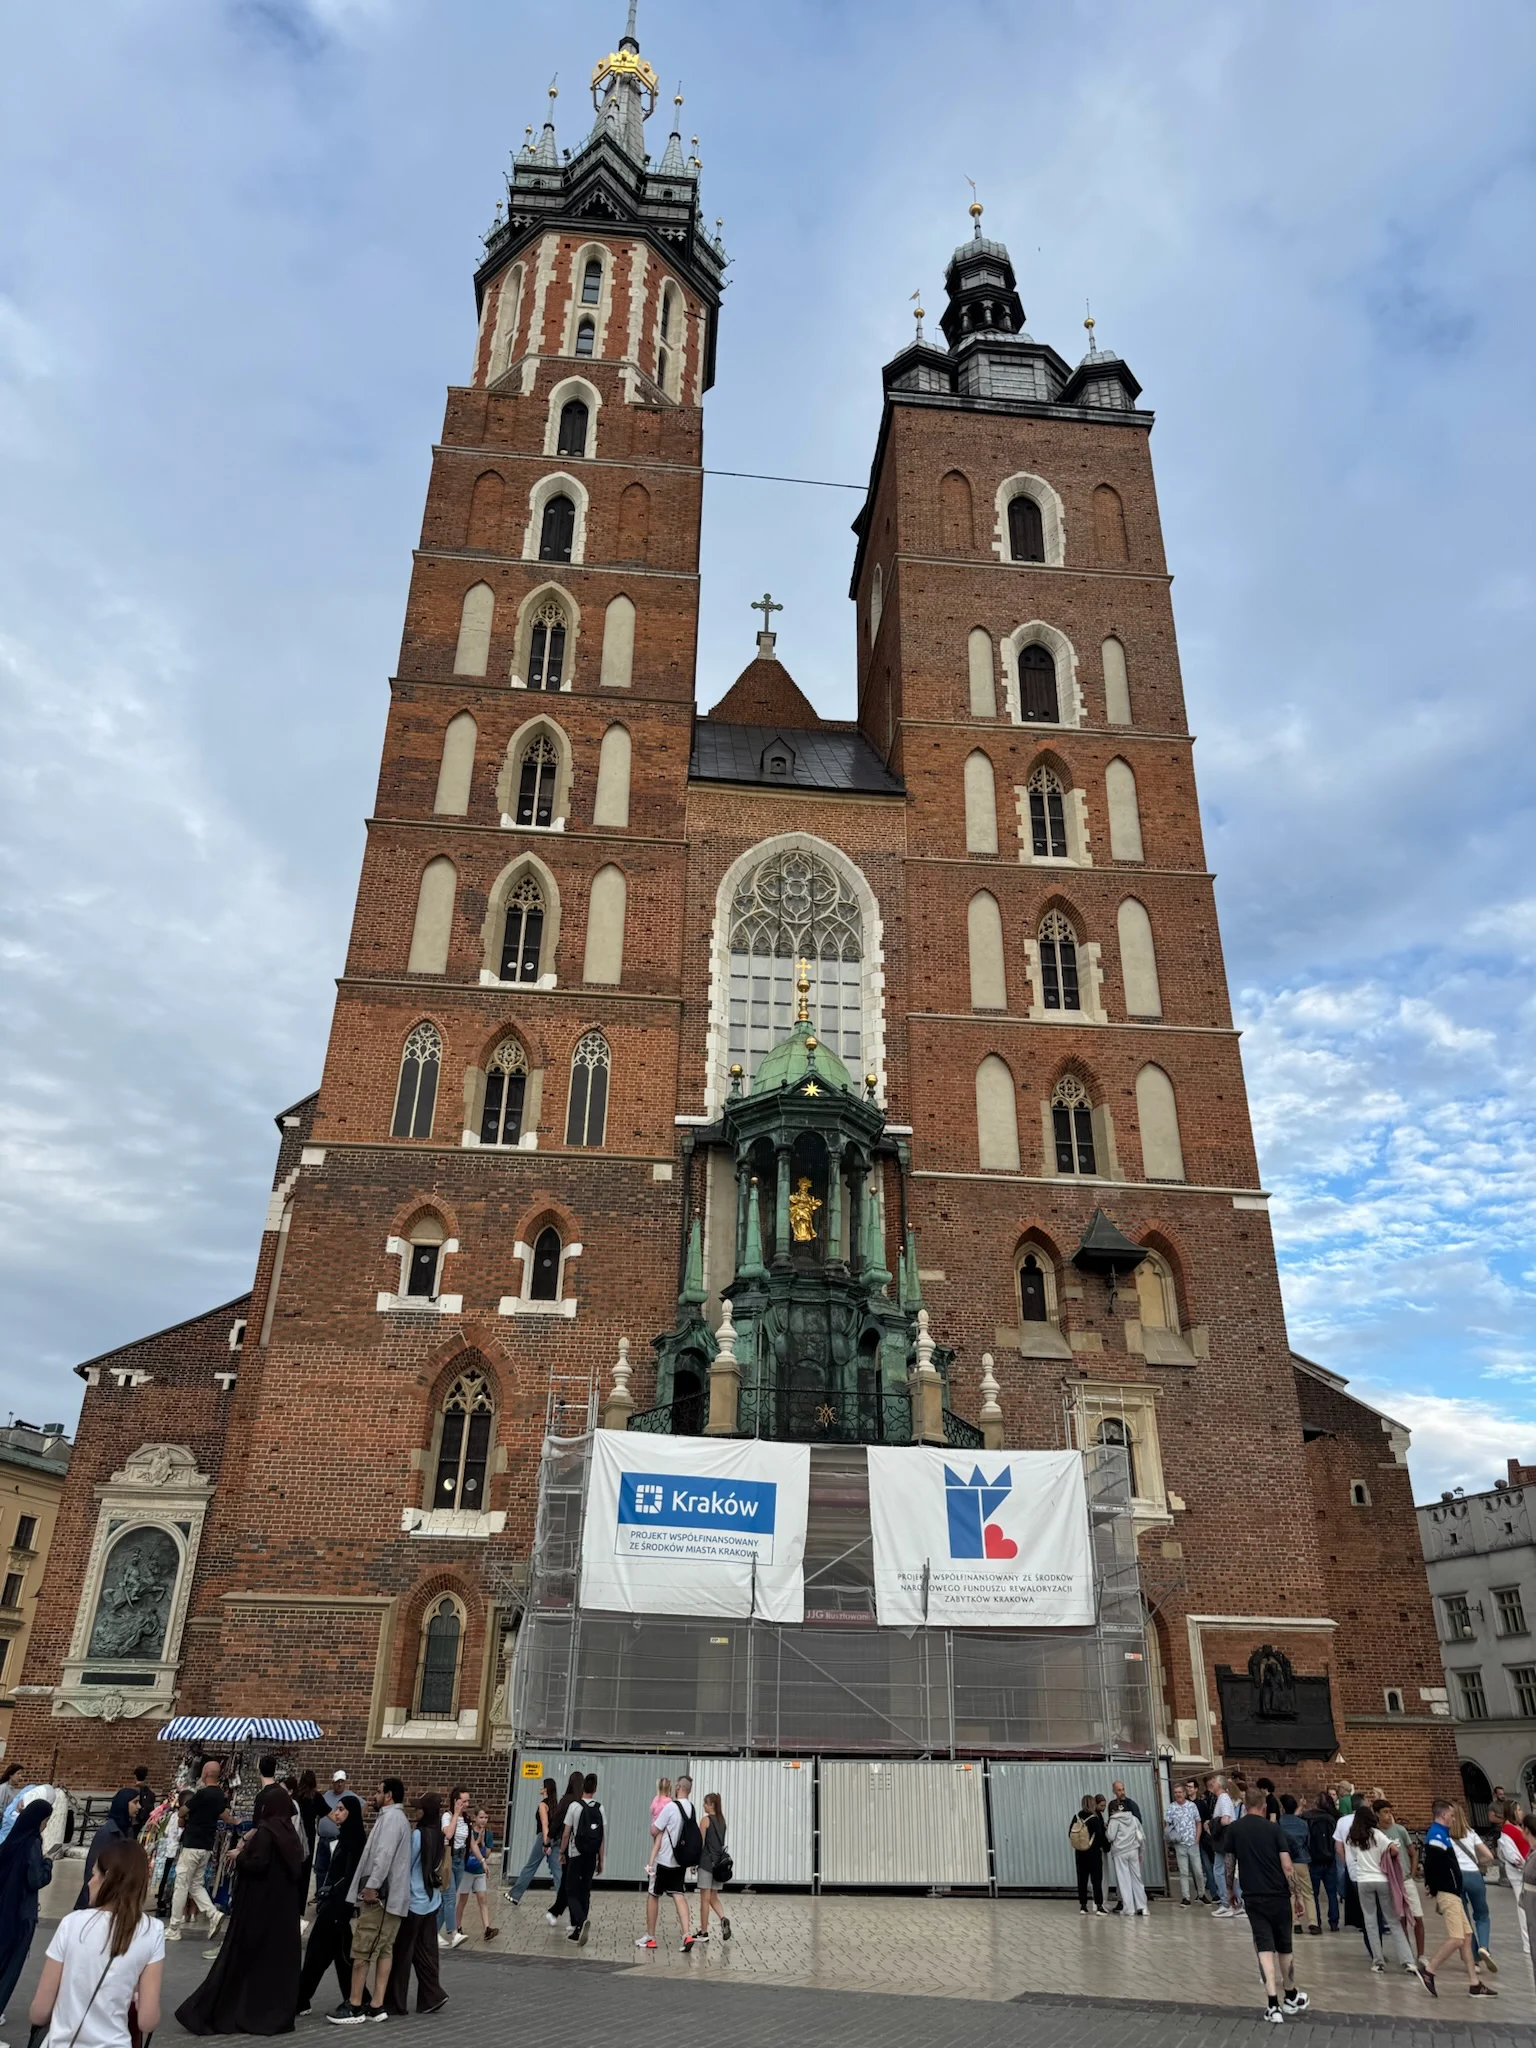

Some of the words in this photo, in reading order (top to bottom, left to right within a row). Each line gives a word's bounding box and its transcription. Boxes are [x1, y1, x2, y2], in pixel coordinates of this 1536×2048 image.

[672, 1490, 759, 1517] Kraków
[630, 1530, 667, 1541] PROJEKT
[669, 1531, 759, 1547] WSPÓŁFINANSOWANY
[629, 1541, 640, 1550] ZE
[641, 1540, 685, 1553] ŚRODKÓW
[686, 1545, 717, 1555] MIASTA
[897, 1573, 924, 1581] PROJEK
[933, 1572, 1020, 1582] WSPÓŁFINANSOWANY
[1022, 1574, 1033, 1582] ZE
[1035, 1572, 1074, 1582] ŚRODKÓW
[900, 1584, 960, 1593] NAROOWEGO
[963, 1584, 1007, 1593] FUNDUSZU
[1010, 1585, 1073, 1594] REWALORYZACJI
[944, 1594, 991, 1603] ZABYTKÓW
[993, 1595, 1035, 1603] KRAKOWA
